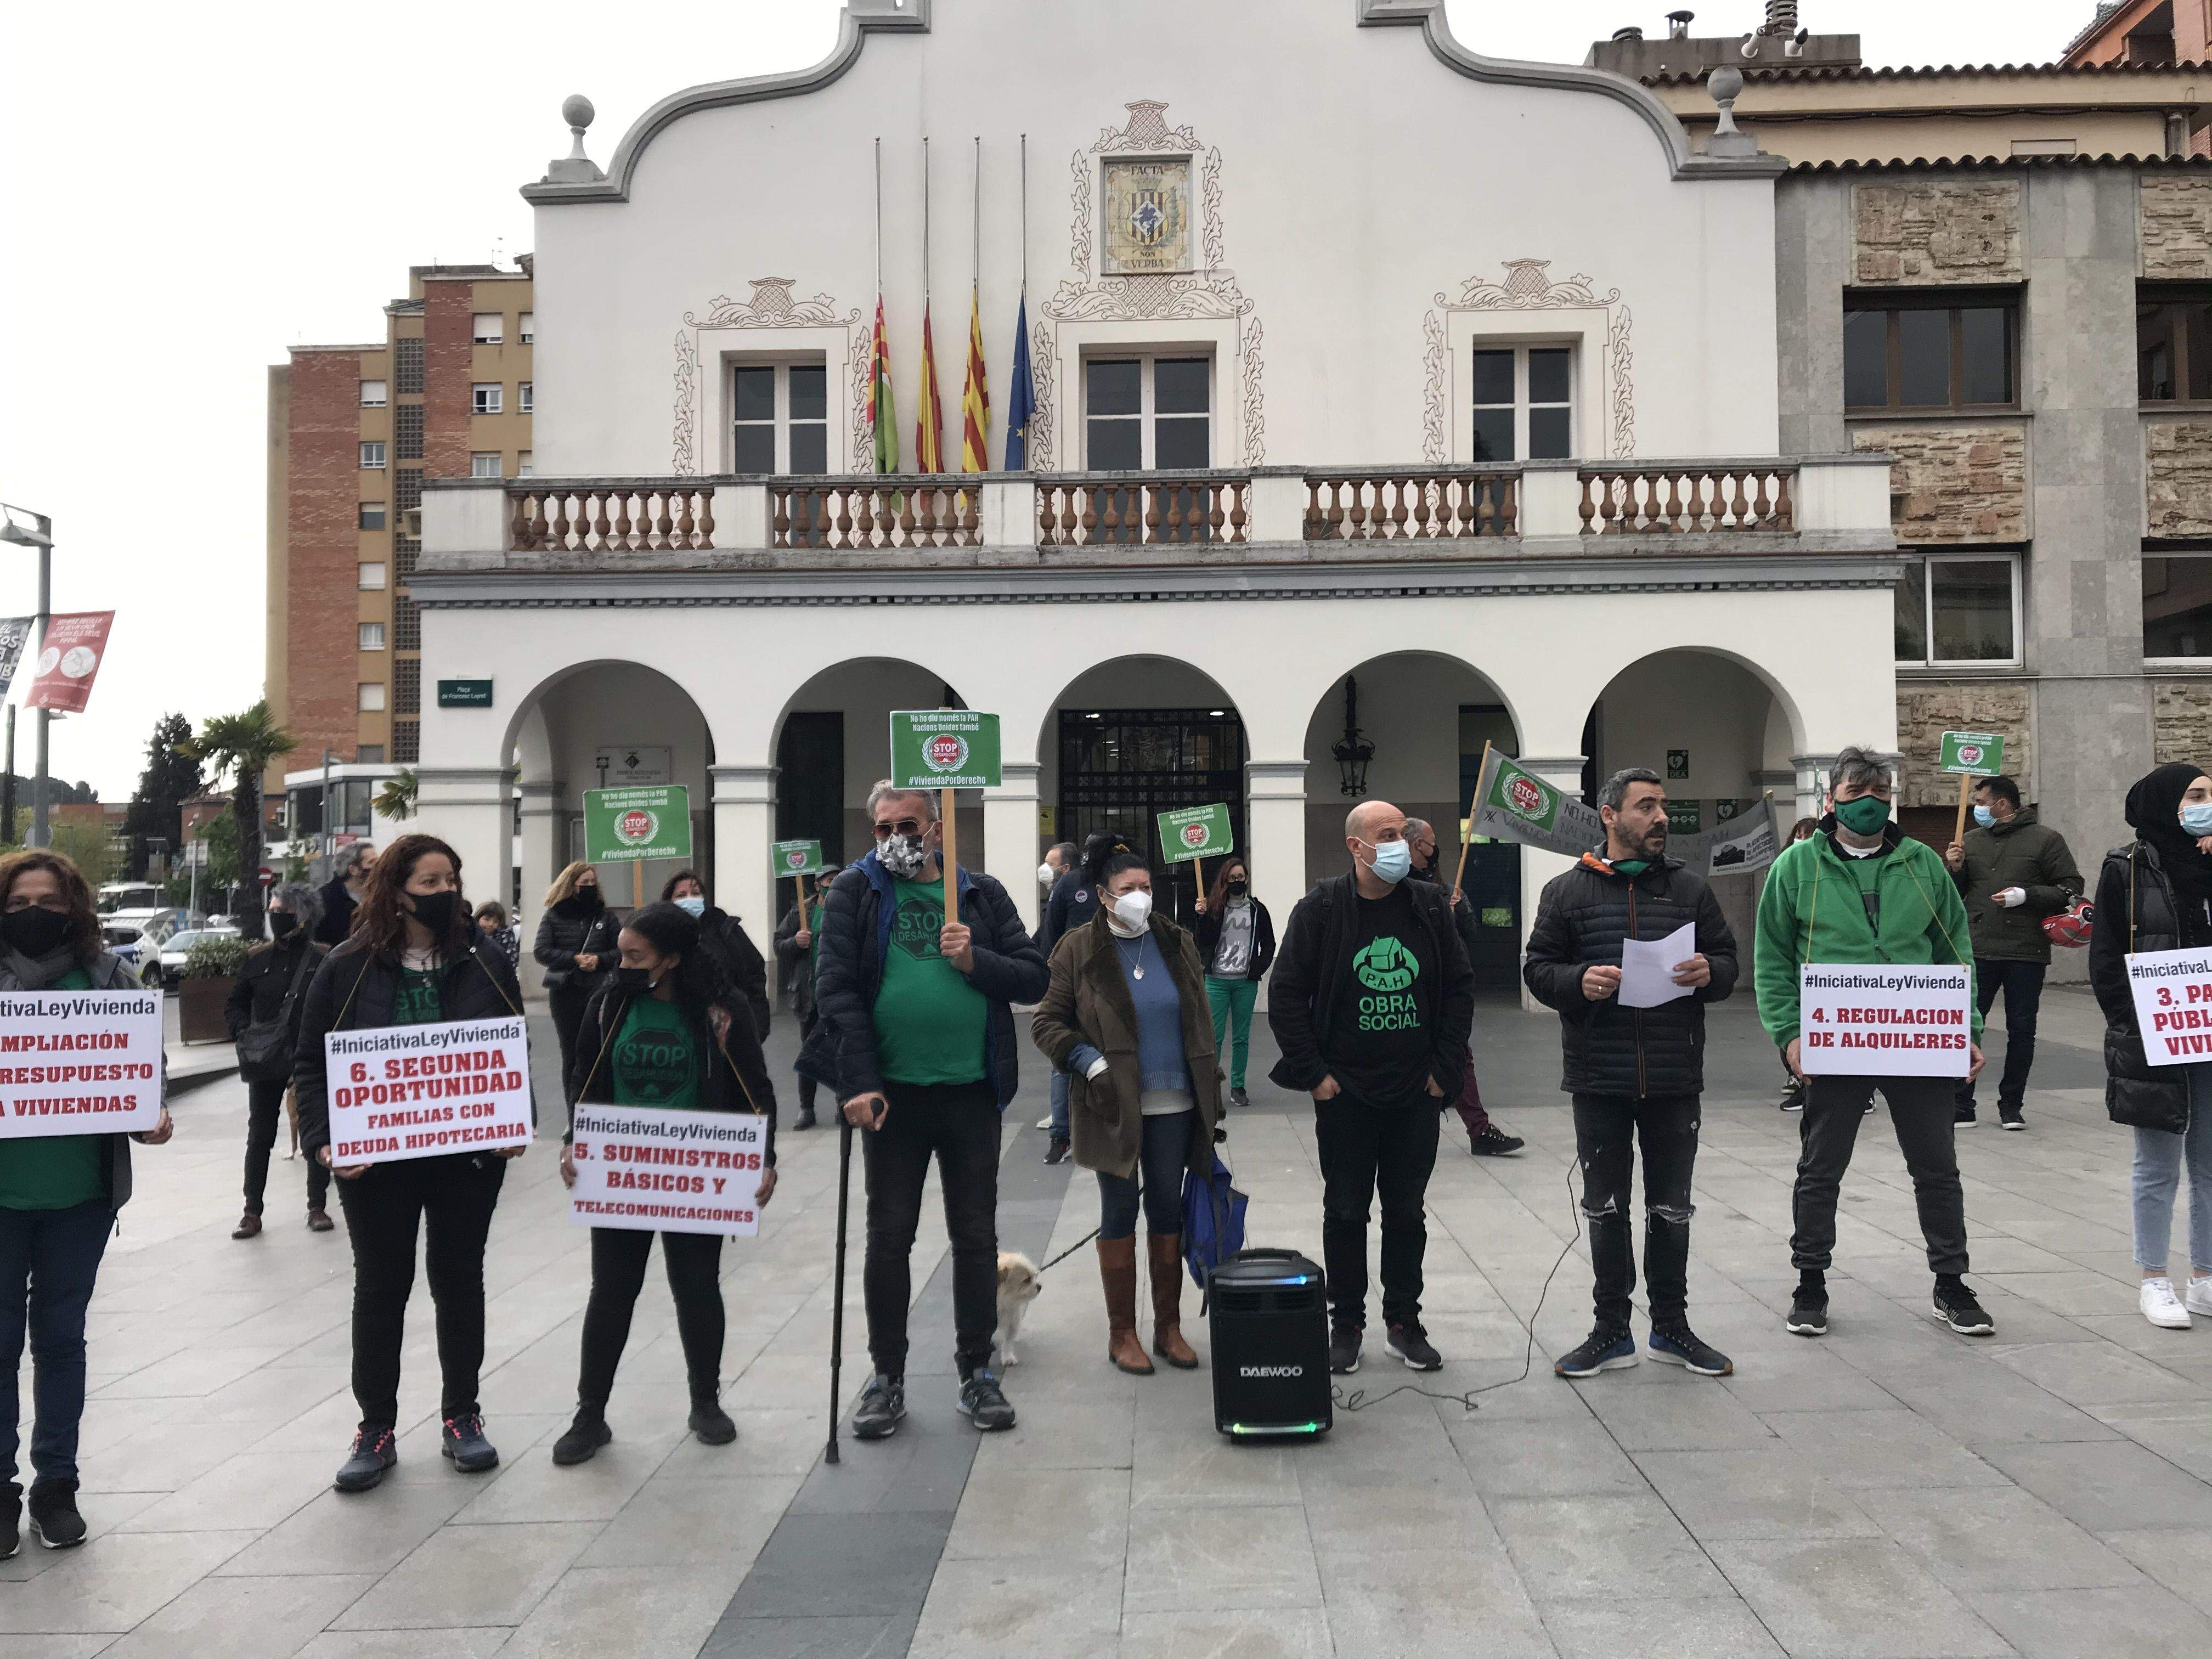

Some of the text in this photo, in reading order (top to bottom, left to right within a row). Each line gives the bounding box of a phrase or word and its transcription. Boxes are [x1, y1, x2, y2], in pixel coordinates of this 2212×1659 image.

[1131, 166, 1164, 175] FACTA
[934, 743, 957, 753] STOP
[909, 776, 986, 786] #ViviendaPorDerecho
[1515, 782, 1539, 801] STOP
[624, 818, 647, 827] STOP
[1187, 828, 1203, 837] STOP
[602, 847, 676, 859] #ViviendaPorDerecho
[2131, 960, 2212, 979] #IniciativaL
[1805, 975, 1965, 991] #IniciativaLeyVivienda
[1359, 994, 1417, 1014] OBRA
[2157, 988, 2180, 1006] 3.
[1359, 1013, 1421, 1031] SOCIAL
[1812, 1008, 1963, 1025] 4. REGULACION
[1, 1029, 129, 1052] MPLIACIÓN
[331, 1024, 520, 1055] #IniciativaLeyVivienda
[1809, 1032, 1966, 1049] DE ALQUILERES
[622, 1043, 686, 1068] STOP
[0, 1064, 153, 1085] RESUPUESTO
[350, 1049, 507, 1083] 6. SEGUNDA
[335, 1071, 523, 1109] OPORTUNIDAD
[13, 1095, 137, 1116] VIVIENDAS
[368, 1103, 495, 1130] FAMILIAS CON
[337, 1122, 527, 1157] DEUDA HIPOTECARIA
[575, 1117, 757, 1143] #IniciativaLeyVivienda
[574, 1143, 761, 1171] 5. SUMINISTROS
[607, 1168, 726, 1195] BÁSICOS Y
[574, 1200, 754, 1223] TELECOMUNICACIONES
[1240, 1366, 1303, 1377] DAEWOO
